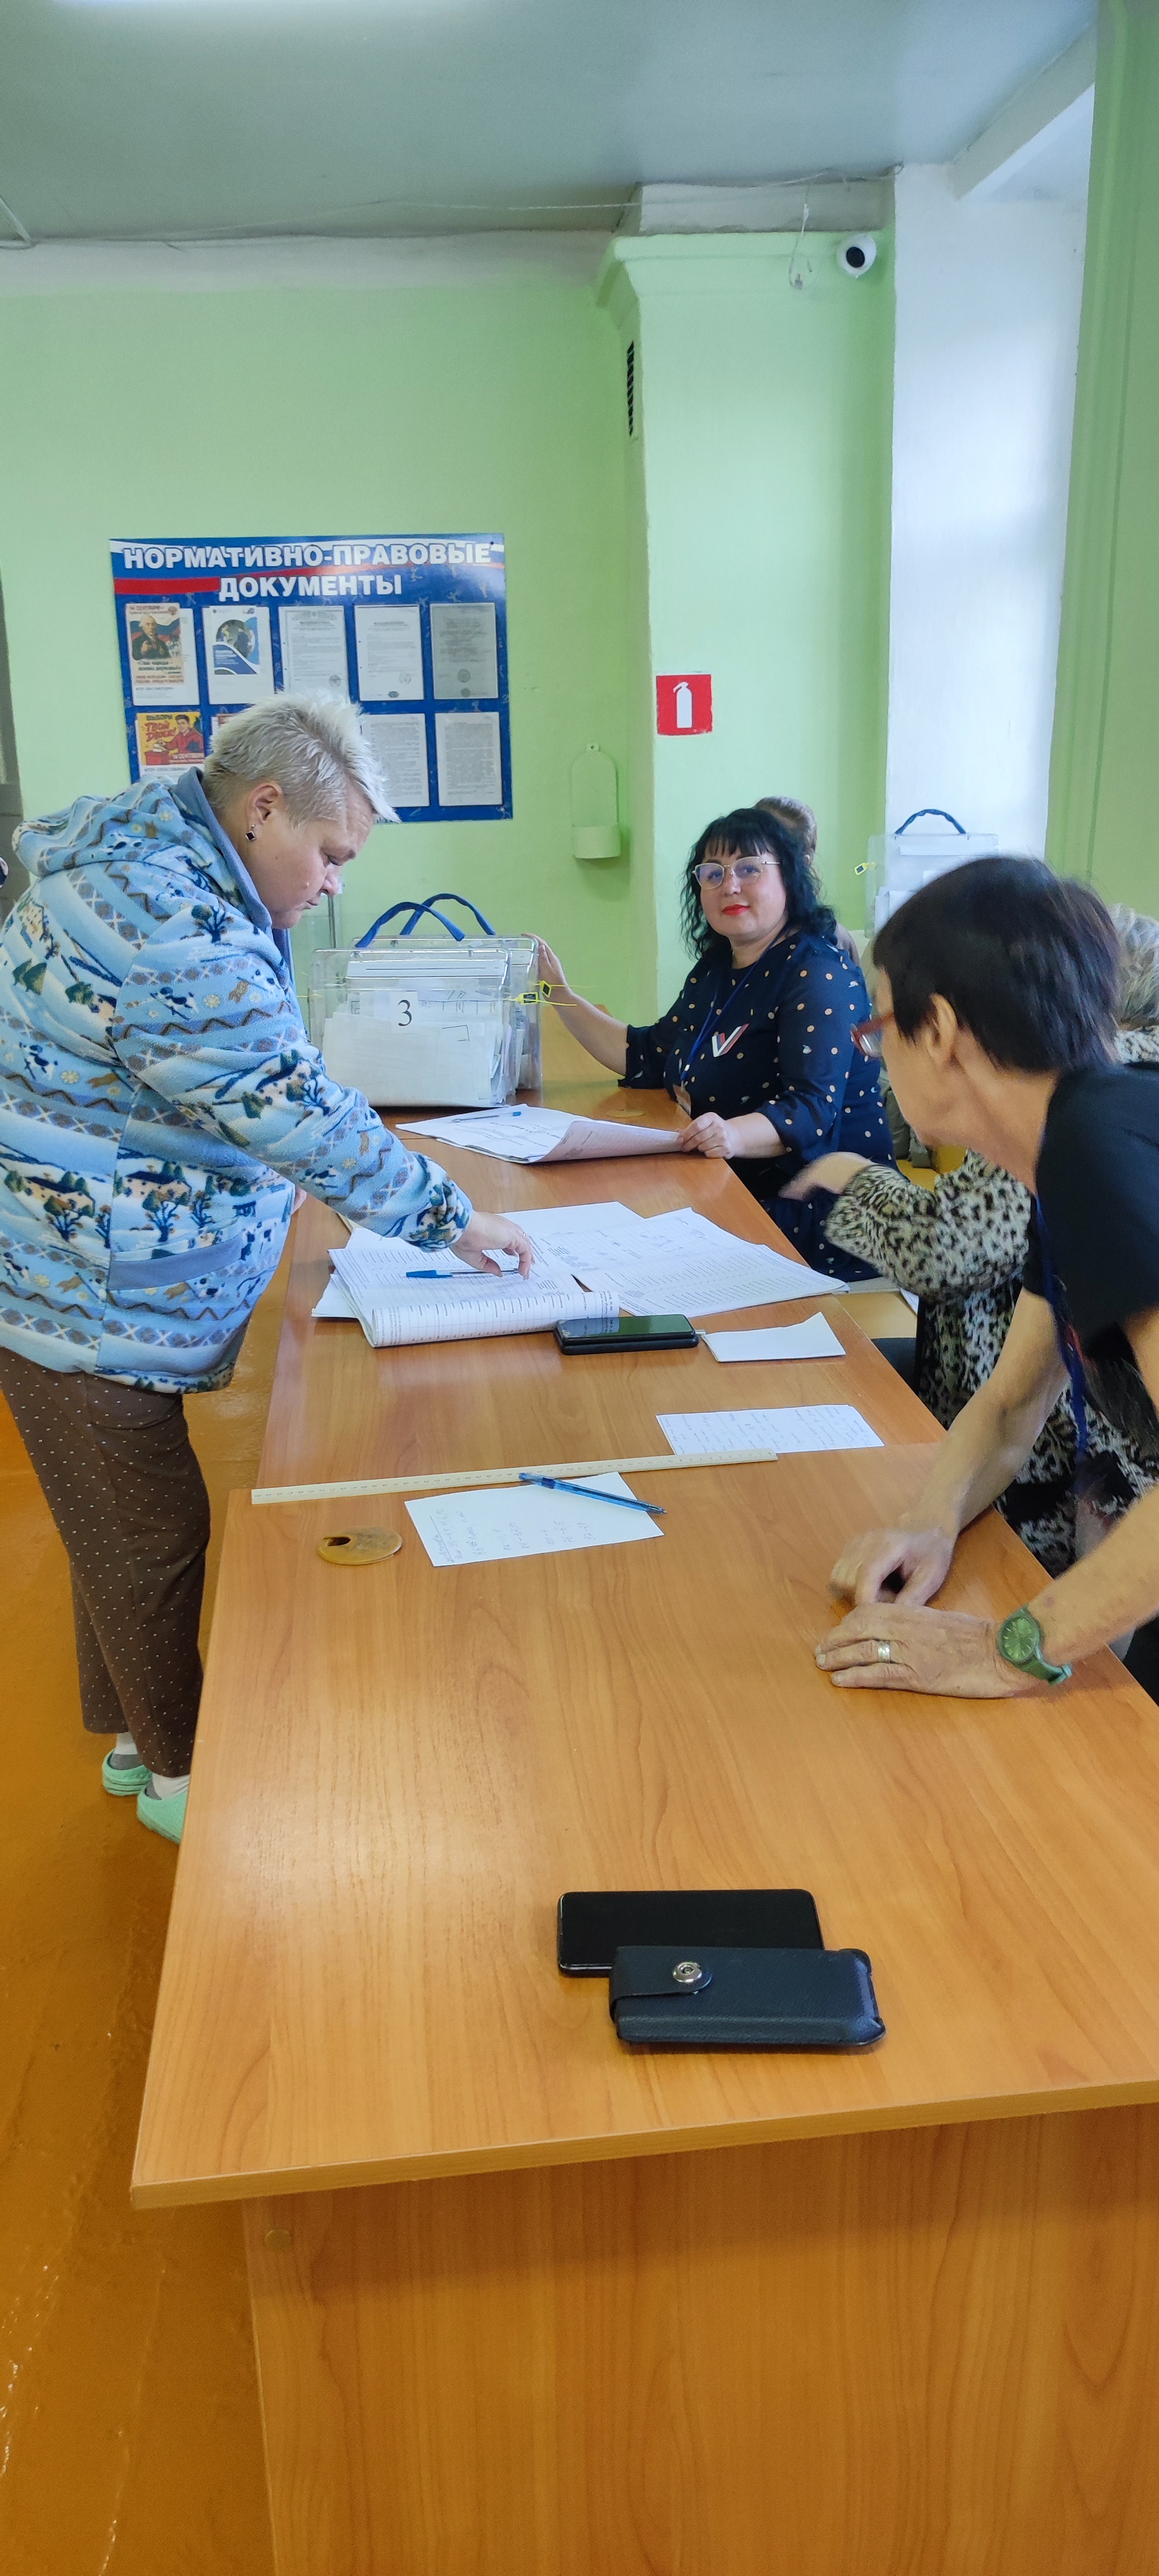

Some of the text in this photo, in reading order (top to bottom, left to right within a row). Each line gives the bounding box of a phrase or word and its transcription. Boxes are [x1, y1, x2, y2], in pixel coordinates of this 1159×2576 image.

[123, 542, 492, 568] НОРМАТИВНО-ПРАВОВЫЕ
[218, 575, 402, 602] ДОКУМЕНТЫ
[398, 999, 412, 1027] 3
